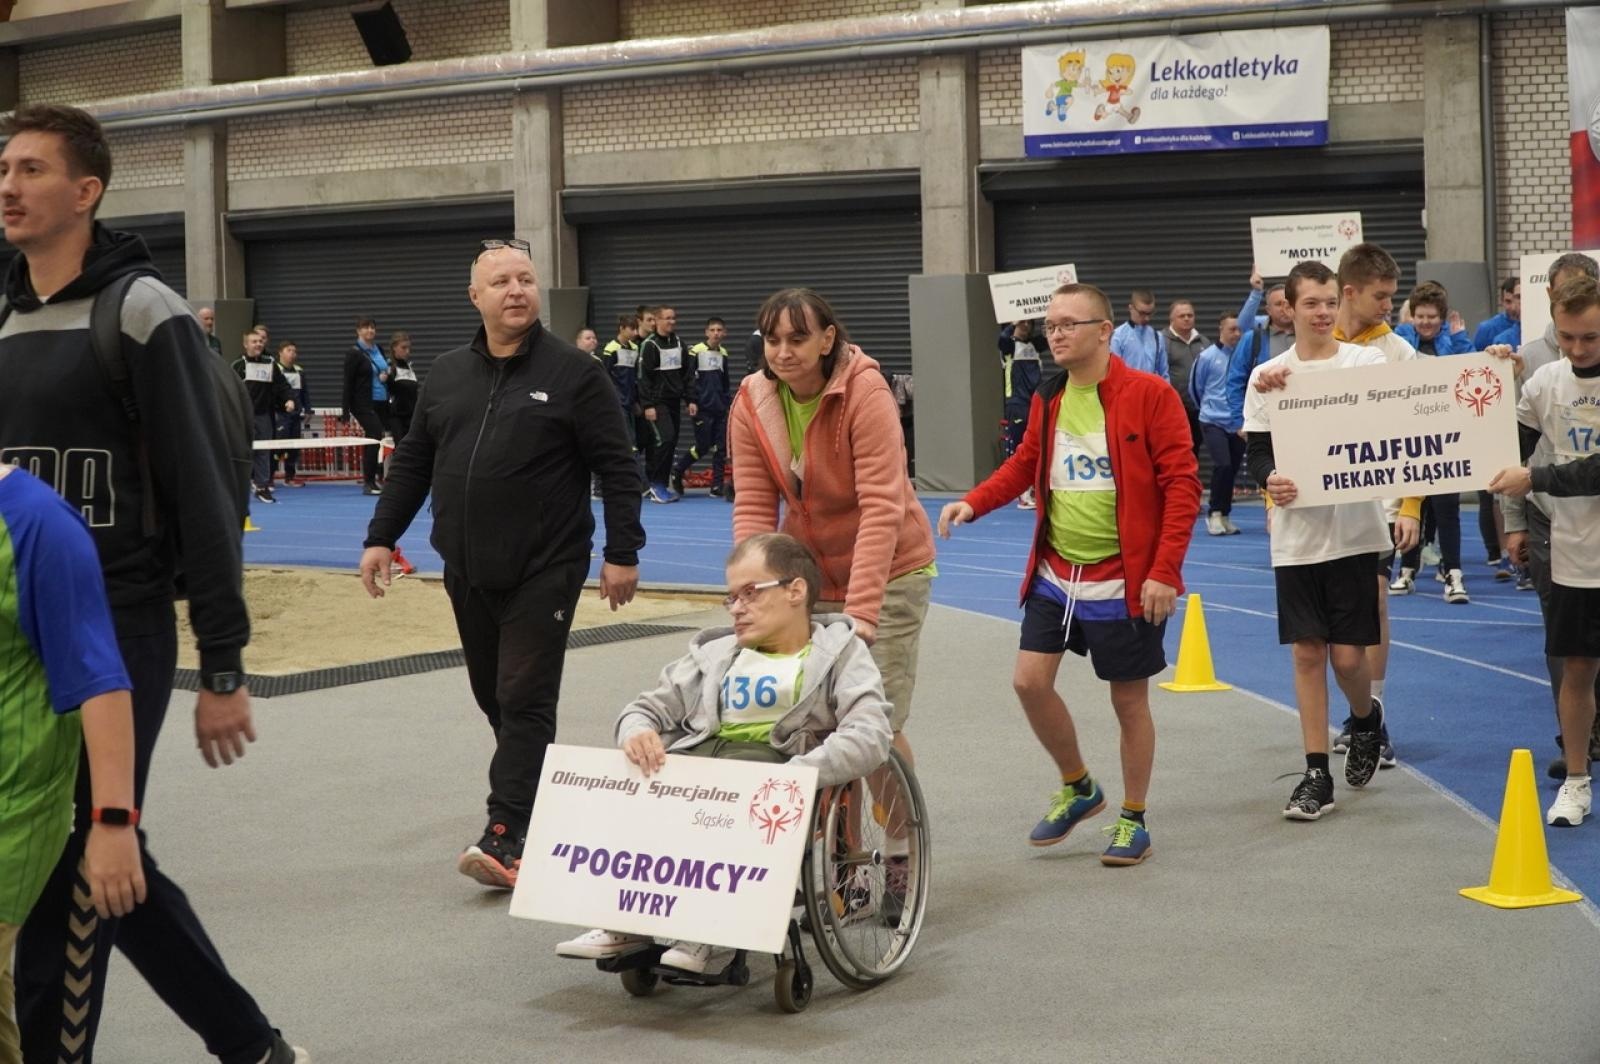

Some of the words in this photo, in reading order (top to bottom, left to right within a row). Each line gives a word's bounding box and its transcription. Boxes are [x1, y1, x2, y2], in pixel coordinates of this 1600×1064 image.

[1150, 54, 1299, 82] Lekkoatletyka
[1150, 87, 1169, 101] dla
[1172, 85, 1229, 101] każdego!
[1280, 247, 1337, 259] "MOTYL"
[1278, 391, 1359, 411] Olimpiady
[1366, 383, 1449, 402] Specjalne
[1412, 402, 1451, 417] Śląskie
[1327, 431, 1462, 465] "TAJFUN"
[1063, 453, 1114, 481] 139
[1322, 467, 1396, 491] PIEKARY
[1402, 459, 1472, 485] ŚLĄSKIE
[723, 675, 778, 710] 136
[550, 770, 641, 796] Olimpiady
[647, 780, 741, 803] Specjalne
[691, 808, 736, 830] Śląskie
[551, 843, 770, 894] "POGROMCY"
[618, 888, 678, 918] WYRY
